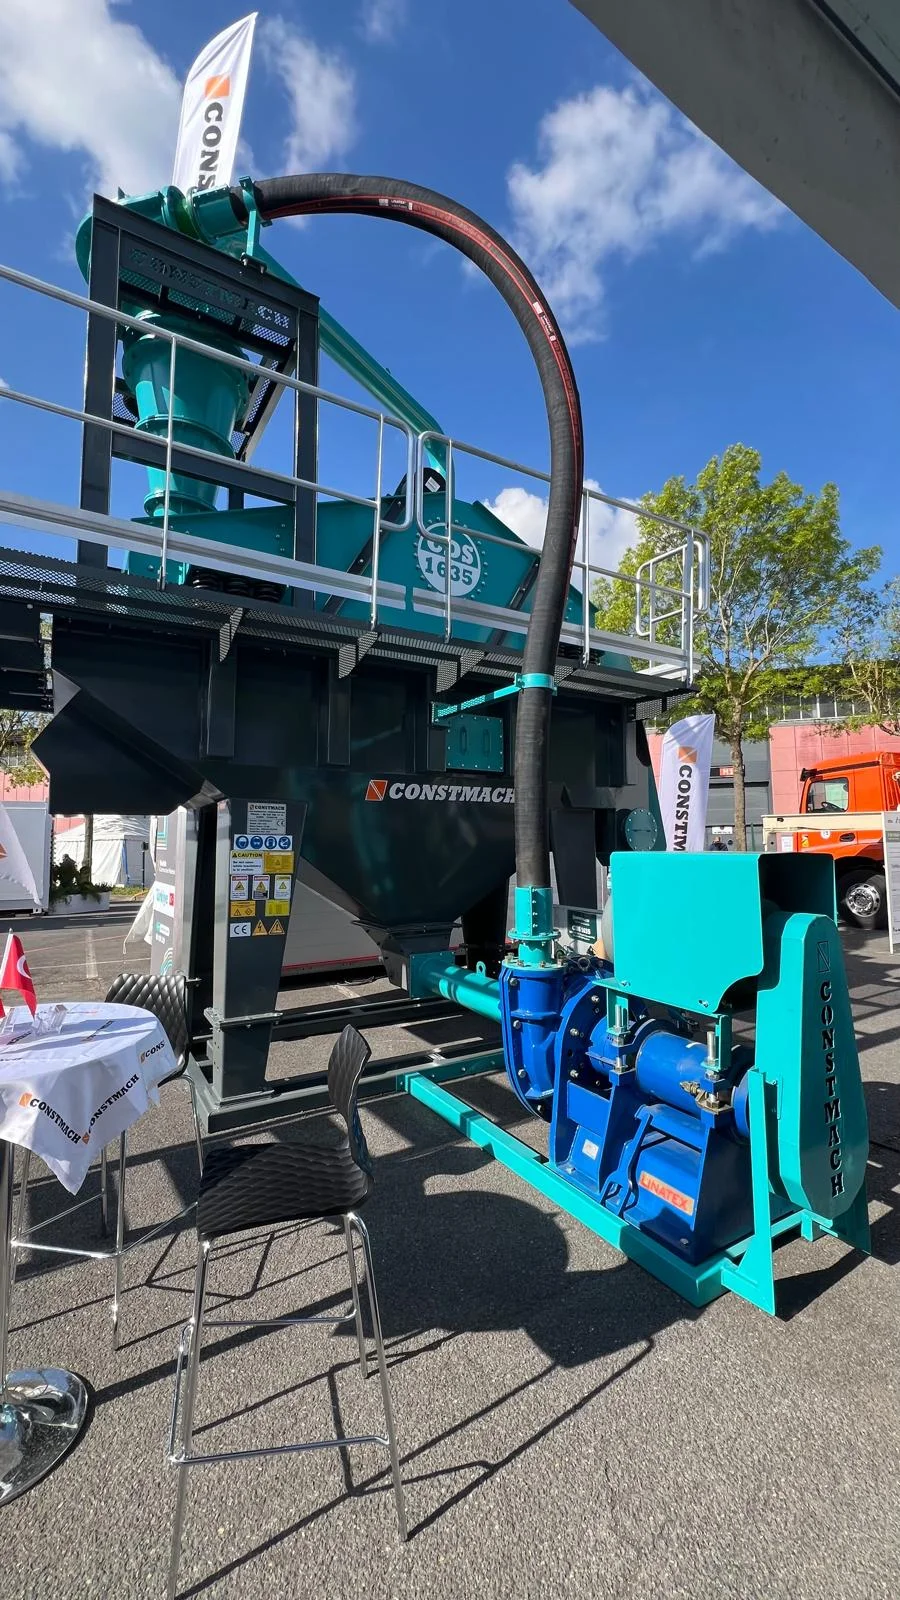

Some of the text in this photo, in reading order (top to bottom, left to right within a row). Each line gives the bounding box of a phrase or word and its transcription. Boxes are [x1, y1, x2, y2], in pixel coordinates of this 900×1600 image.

[424, 556, 474, 586] 1635
[388, 782, 516, 804] CONSTMACH
[819, 981, 846, 1198] CONSTMACH
[29, 1098, 82, 1144] CONSTMACH
[640, 1173, 689, 1211] LINATEX
